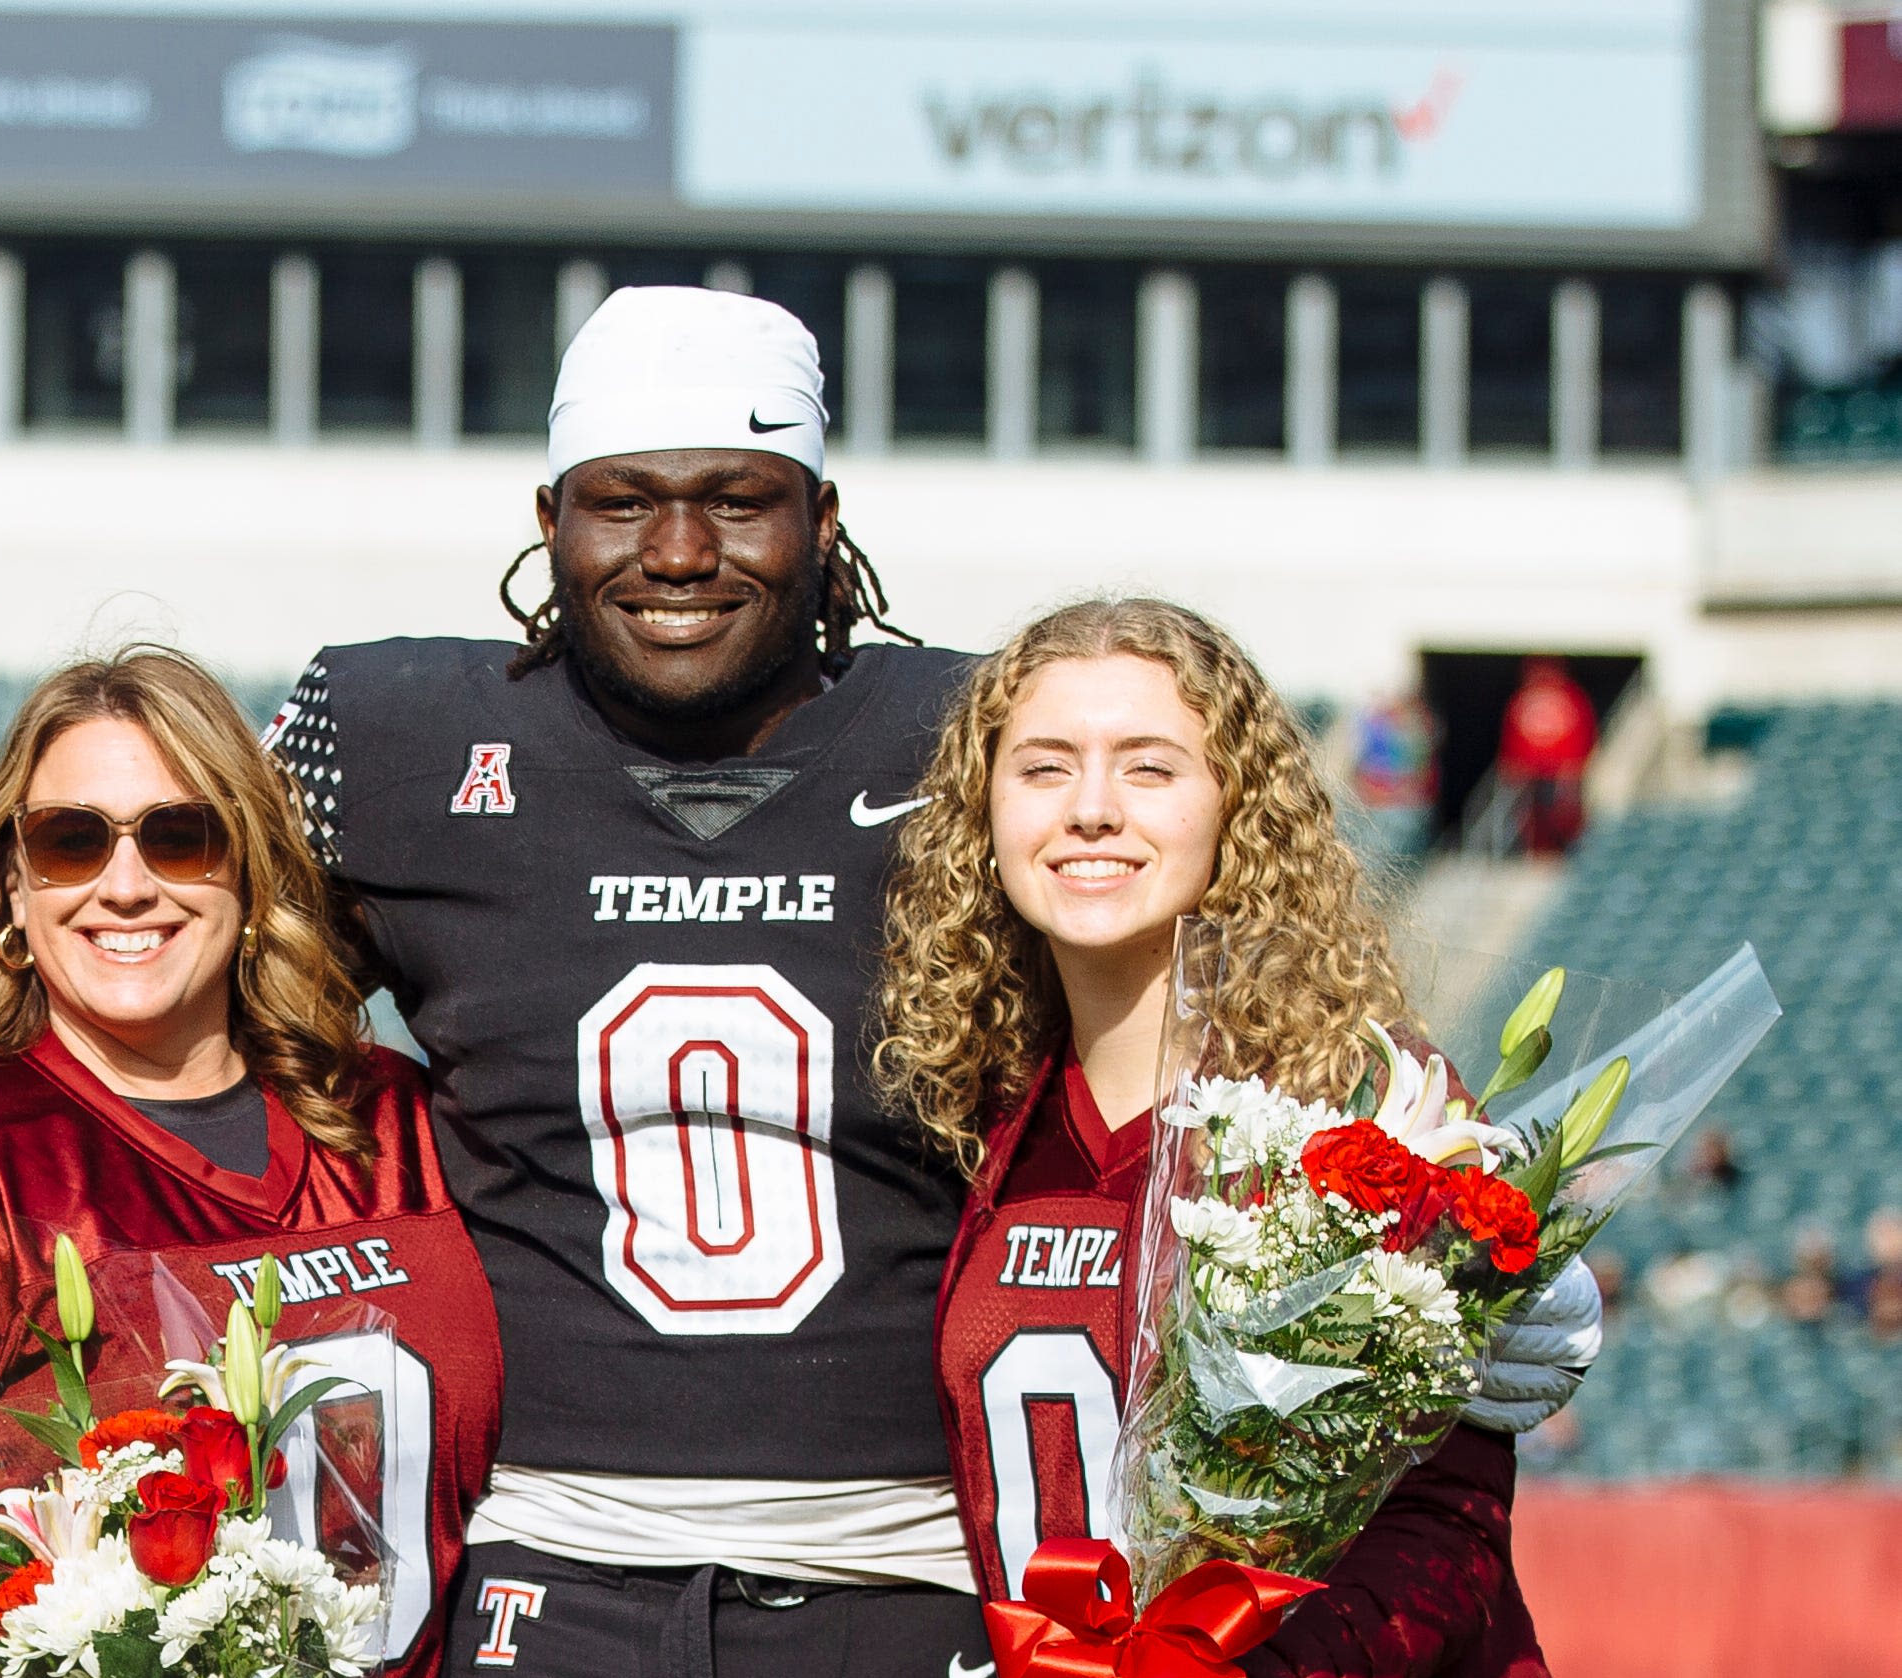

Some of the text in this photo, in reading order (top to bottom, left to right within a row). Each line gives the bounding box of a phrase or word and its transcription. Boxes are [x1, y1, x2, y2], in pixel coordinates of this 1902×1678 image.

[450, 743, 517, 814] A
[588, 874, 836, 922] TEMPLE
[578, 962, 845, 1335] 0
[998, 1224, 1122, 1287] TEMPL
[473, 1576, 548, 1667] T
